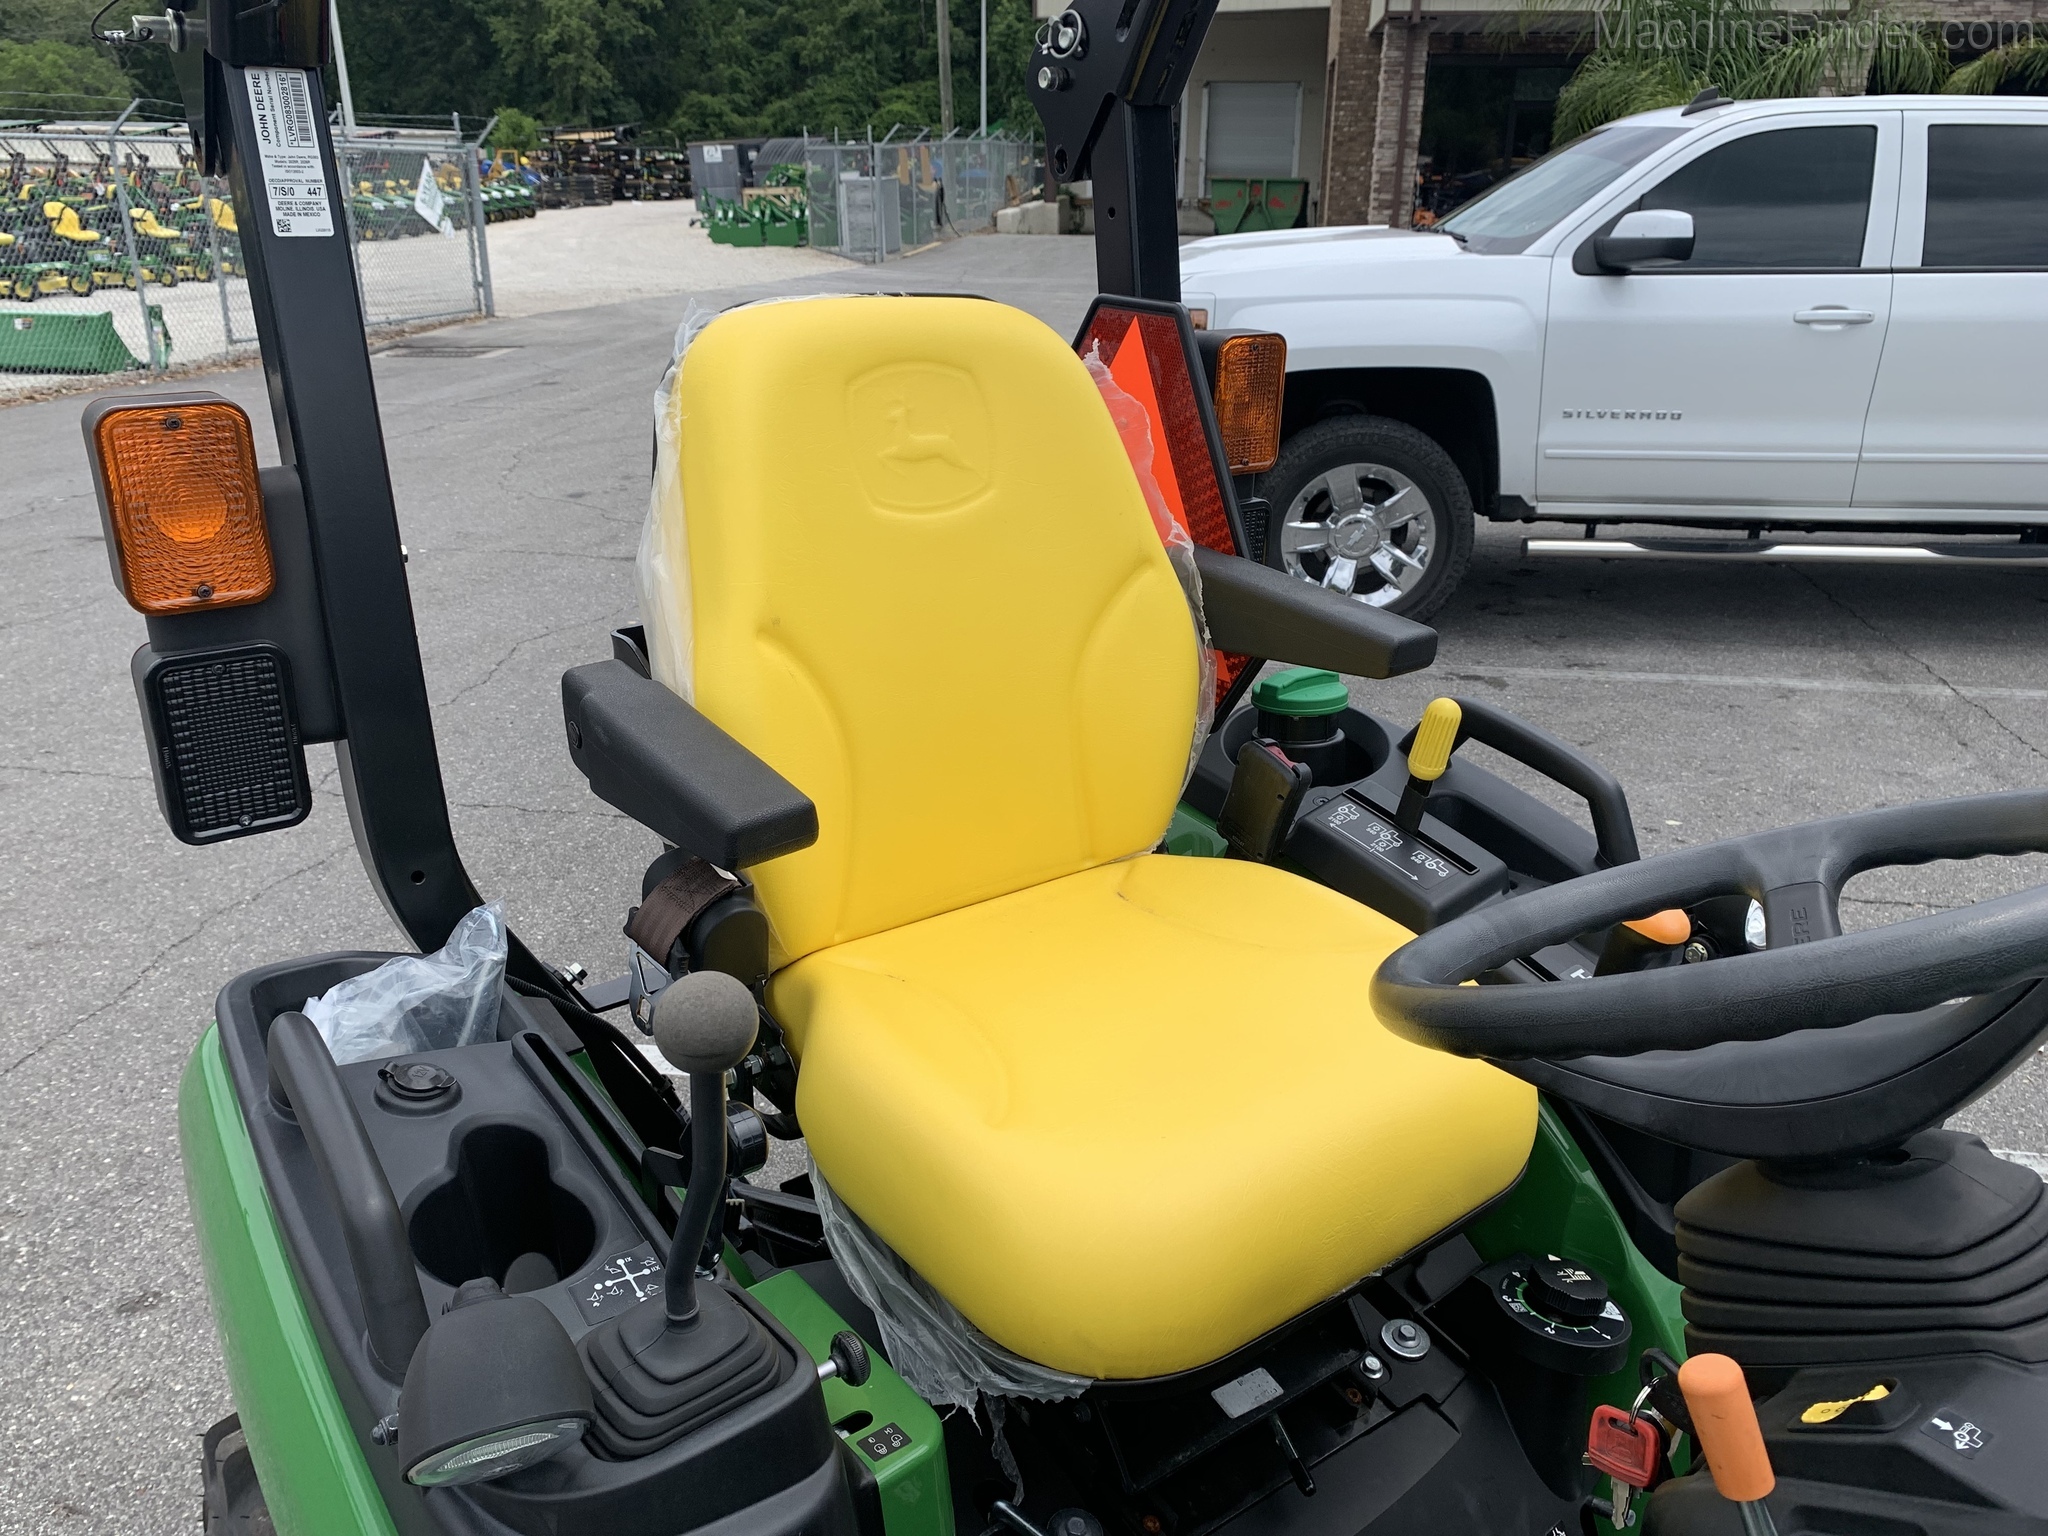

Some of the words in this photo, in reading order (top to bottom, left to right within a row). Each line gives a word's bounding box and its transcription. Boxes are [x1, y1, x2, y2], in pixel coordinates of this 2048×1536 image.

[251, 73, 265, 111] DEERE
[258, 114, 271, 144] JOHN
[272, 114, 281, 147] Component
[272, 186, 295, 196] 7/S/0
[307, 187, 321, 196] 447
[1562, 408, 1683, 421] SILVERADO
[1544, 1326, 1556, 1335] 2
